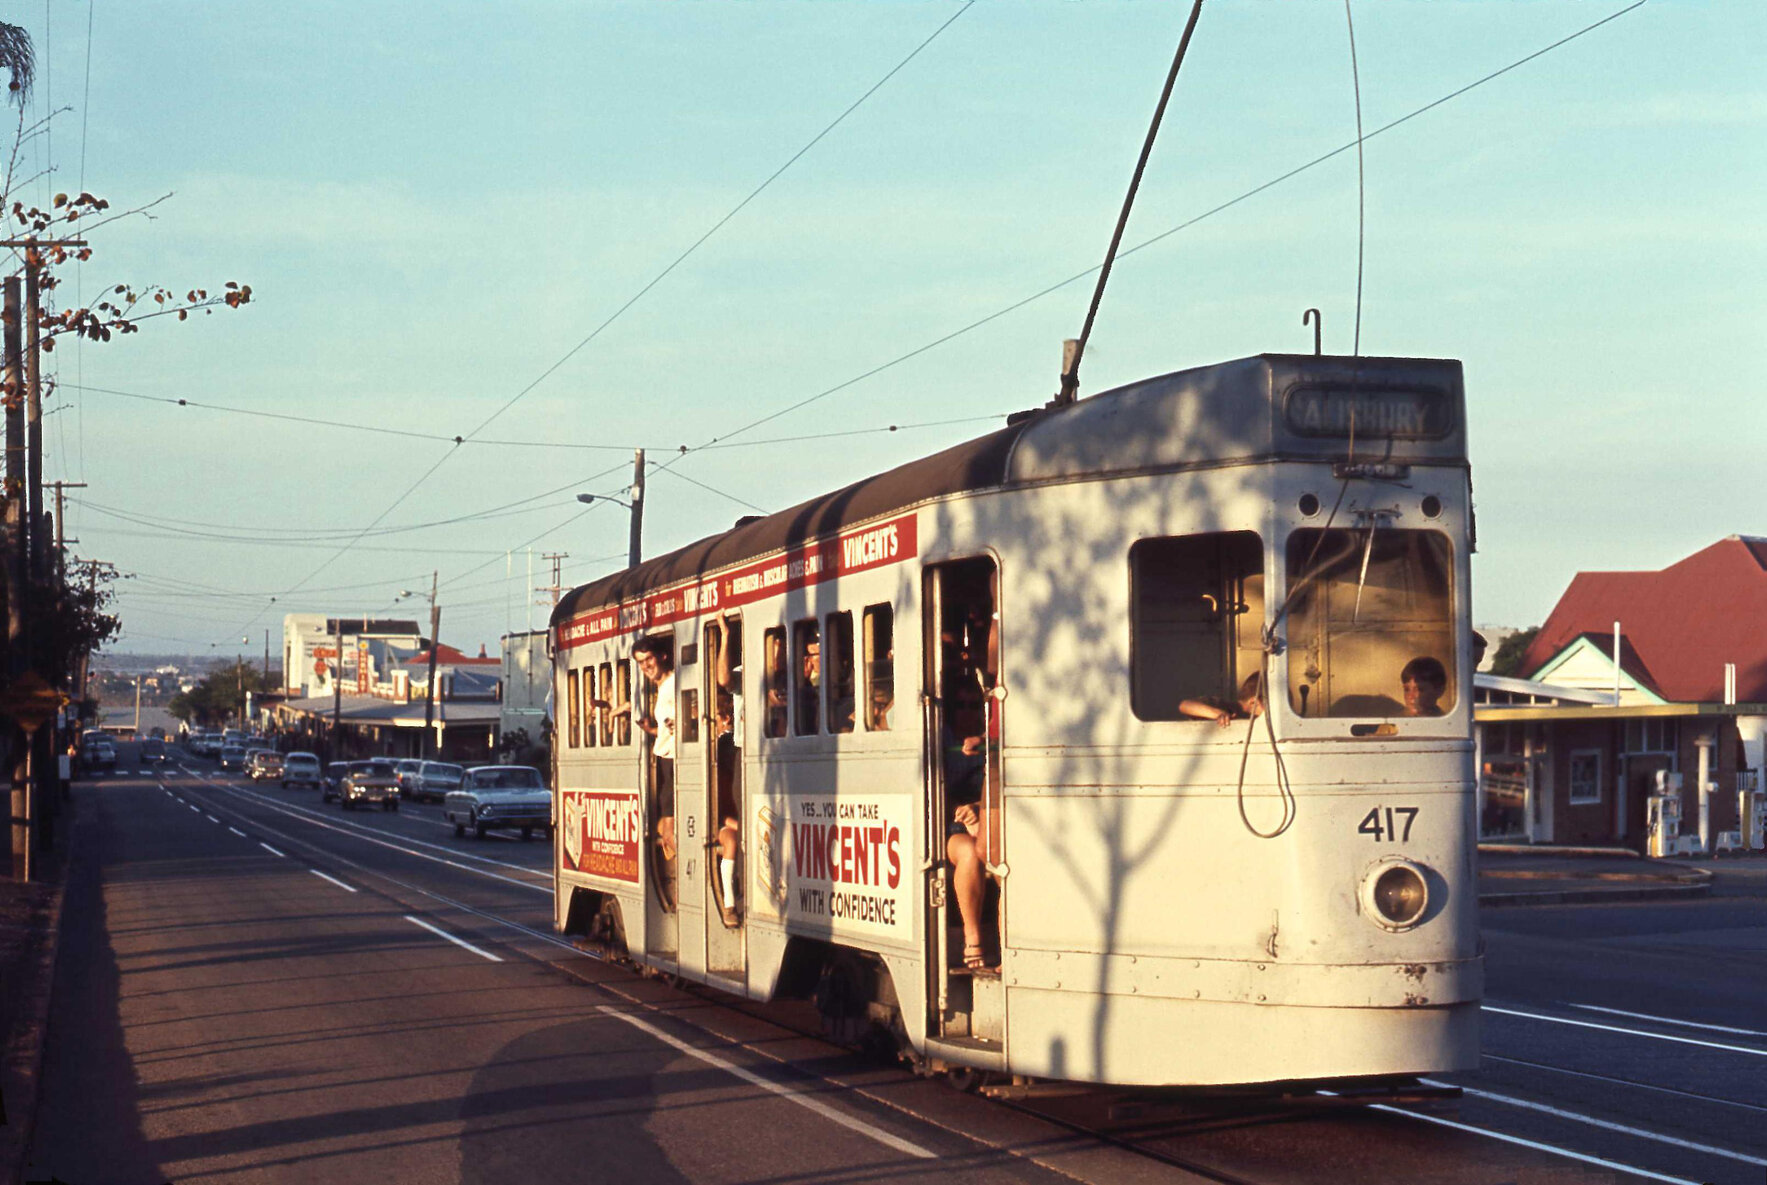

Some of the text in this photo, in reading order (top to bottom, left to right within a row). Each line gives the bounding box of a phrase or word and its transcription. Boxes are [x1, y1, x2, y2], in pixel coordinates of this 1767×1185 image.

[843, 524, 898, 569] VINCENT'S
[684, 580, 718, 613] VINCENT'S
[590, 619, 600, 634] ALL
[586, 794, 639, 843] VINCENT'S
[839, 803, 855, 819] CAN
[858, 804, 878, 819] TAKE
[1358, 807, 1419, 842] 417
[792, 819, 901, 890] VINCENT'S
[799, 887, 896, 926] WITH CONFIDENCE
